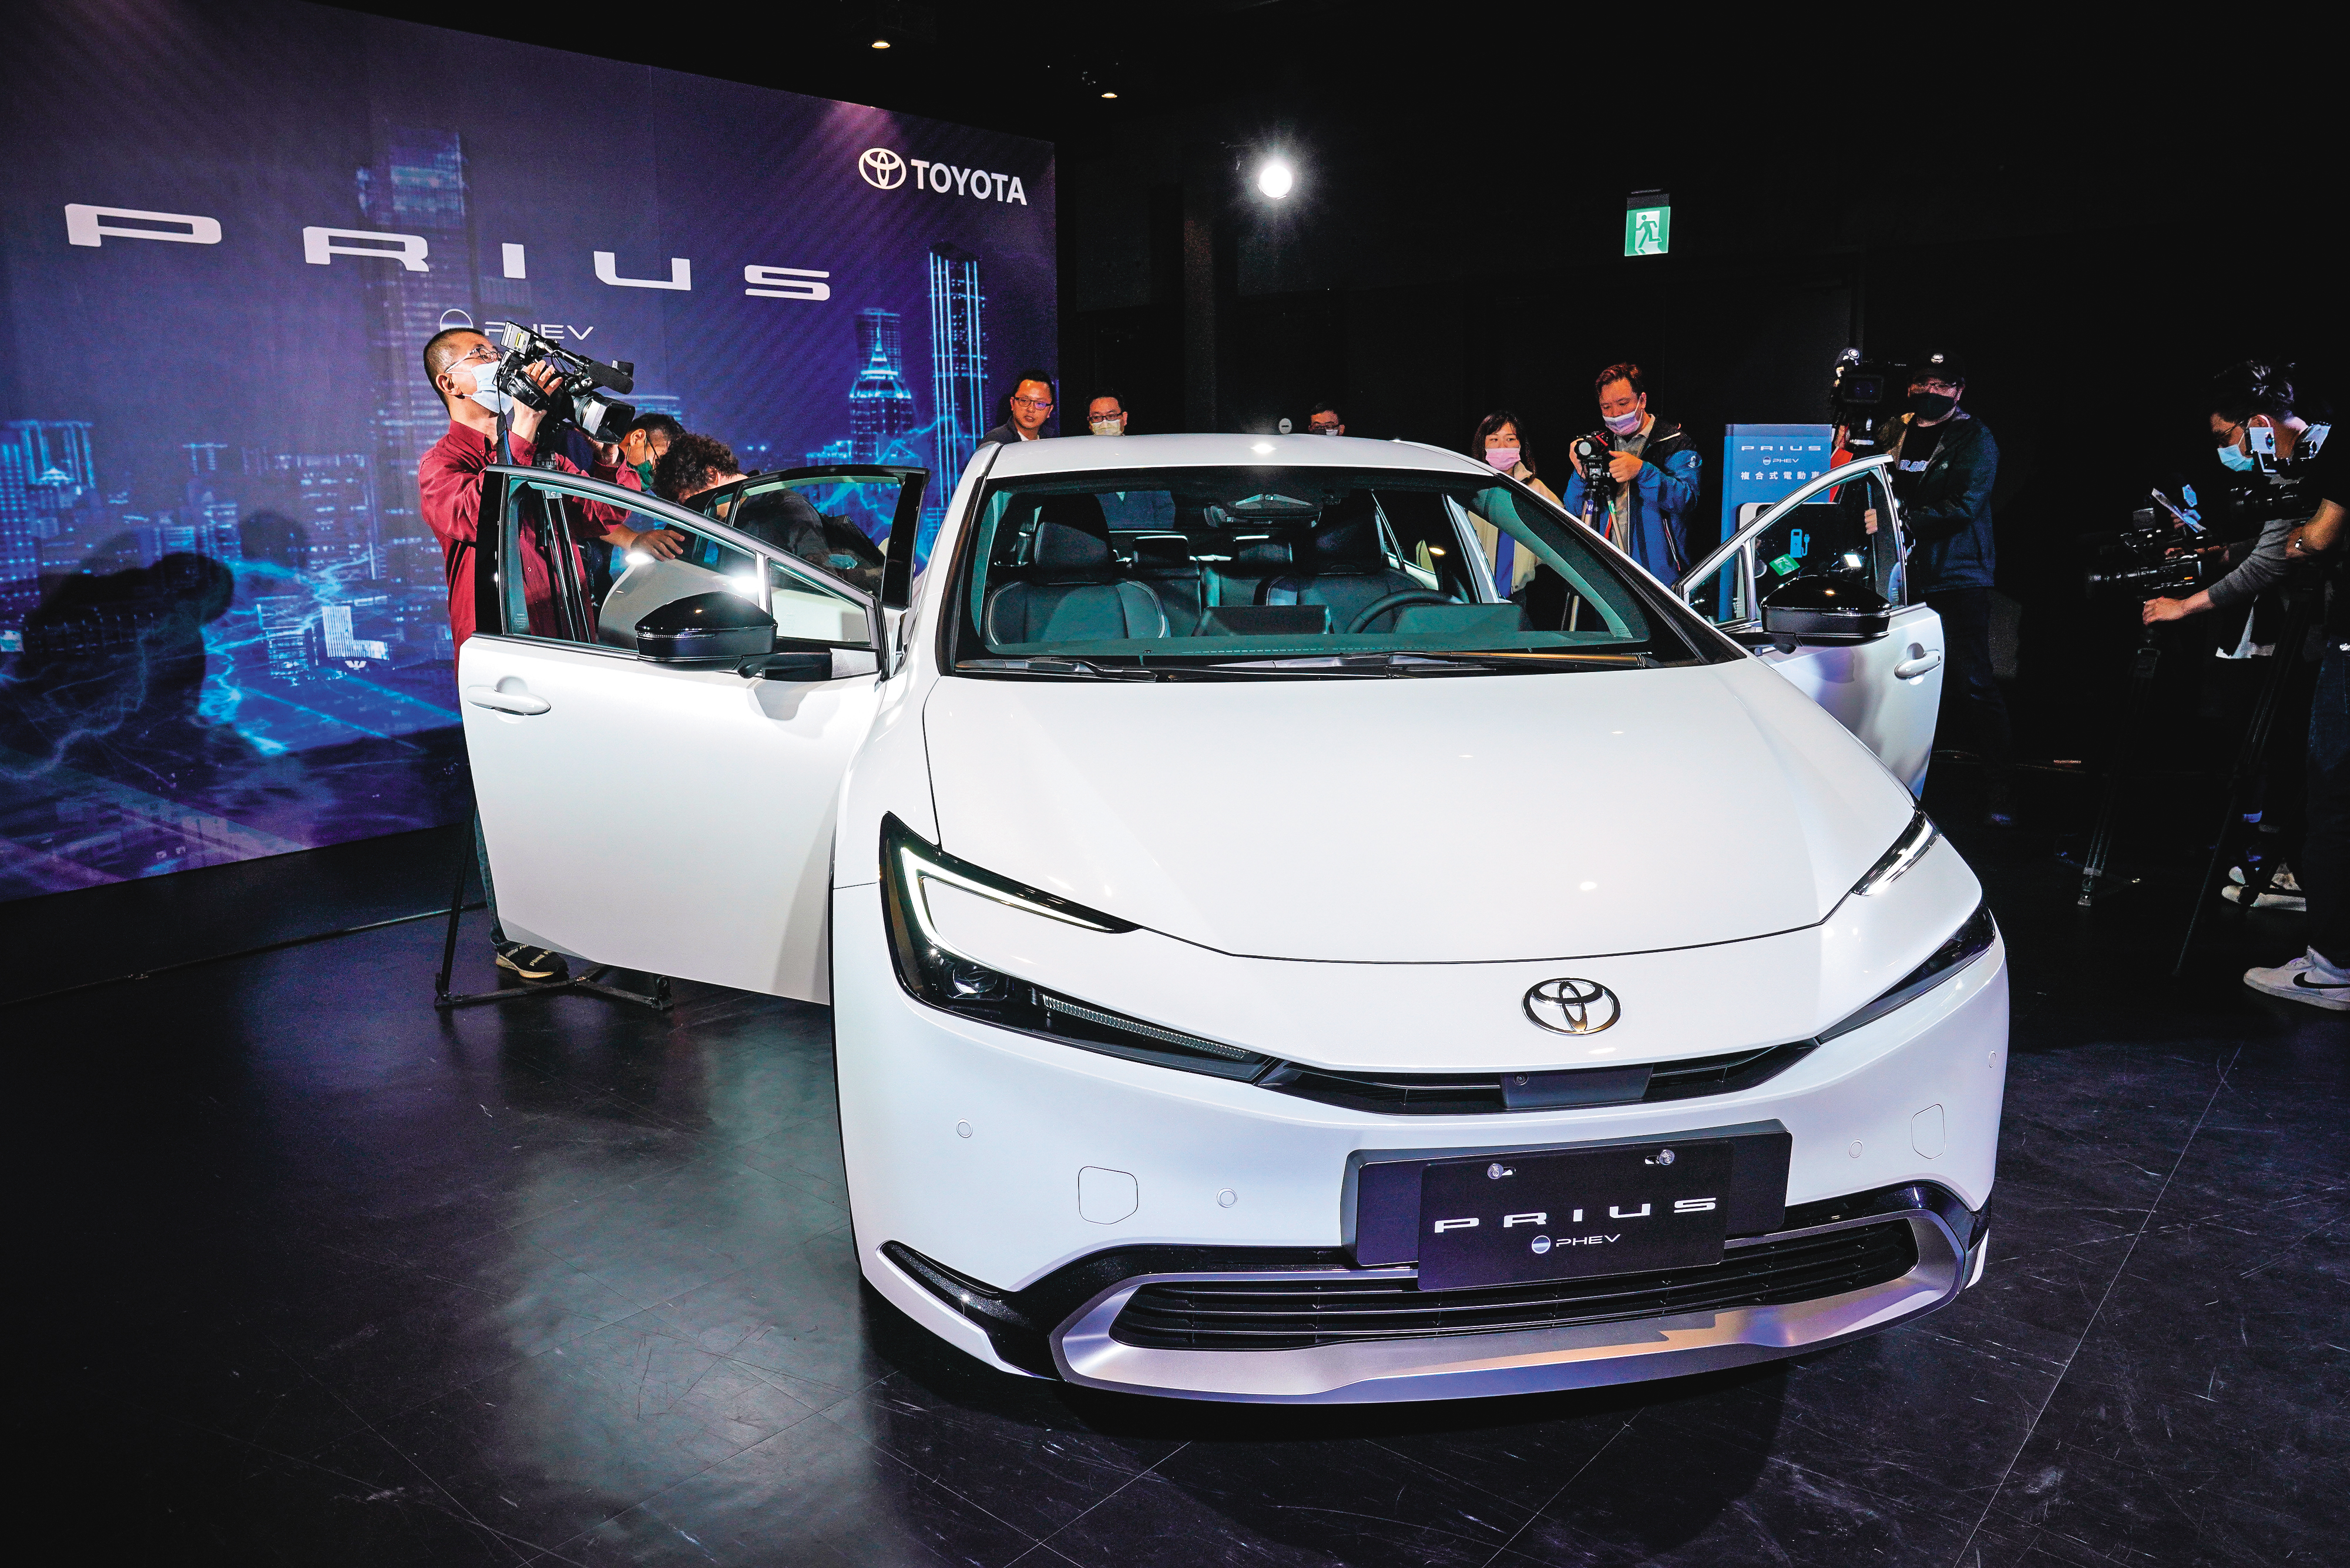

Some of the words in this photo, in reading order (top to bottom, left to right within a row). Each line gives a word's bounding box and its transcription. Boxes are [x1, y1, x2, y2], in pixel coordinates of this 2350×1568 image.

[911, 159, 1028, 206] TOYOTA
[64, 203, 831, 301] PRIUS
[519, 379, 534, 394] SONY
[1740, 471, 1820, 481] 複合式電動車
[1434, 1197, 1717, 1233] PRIUS
[1556, 1234, 1622, 1247] PHEV
